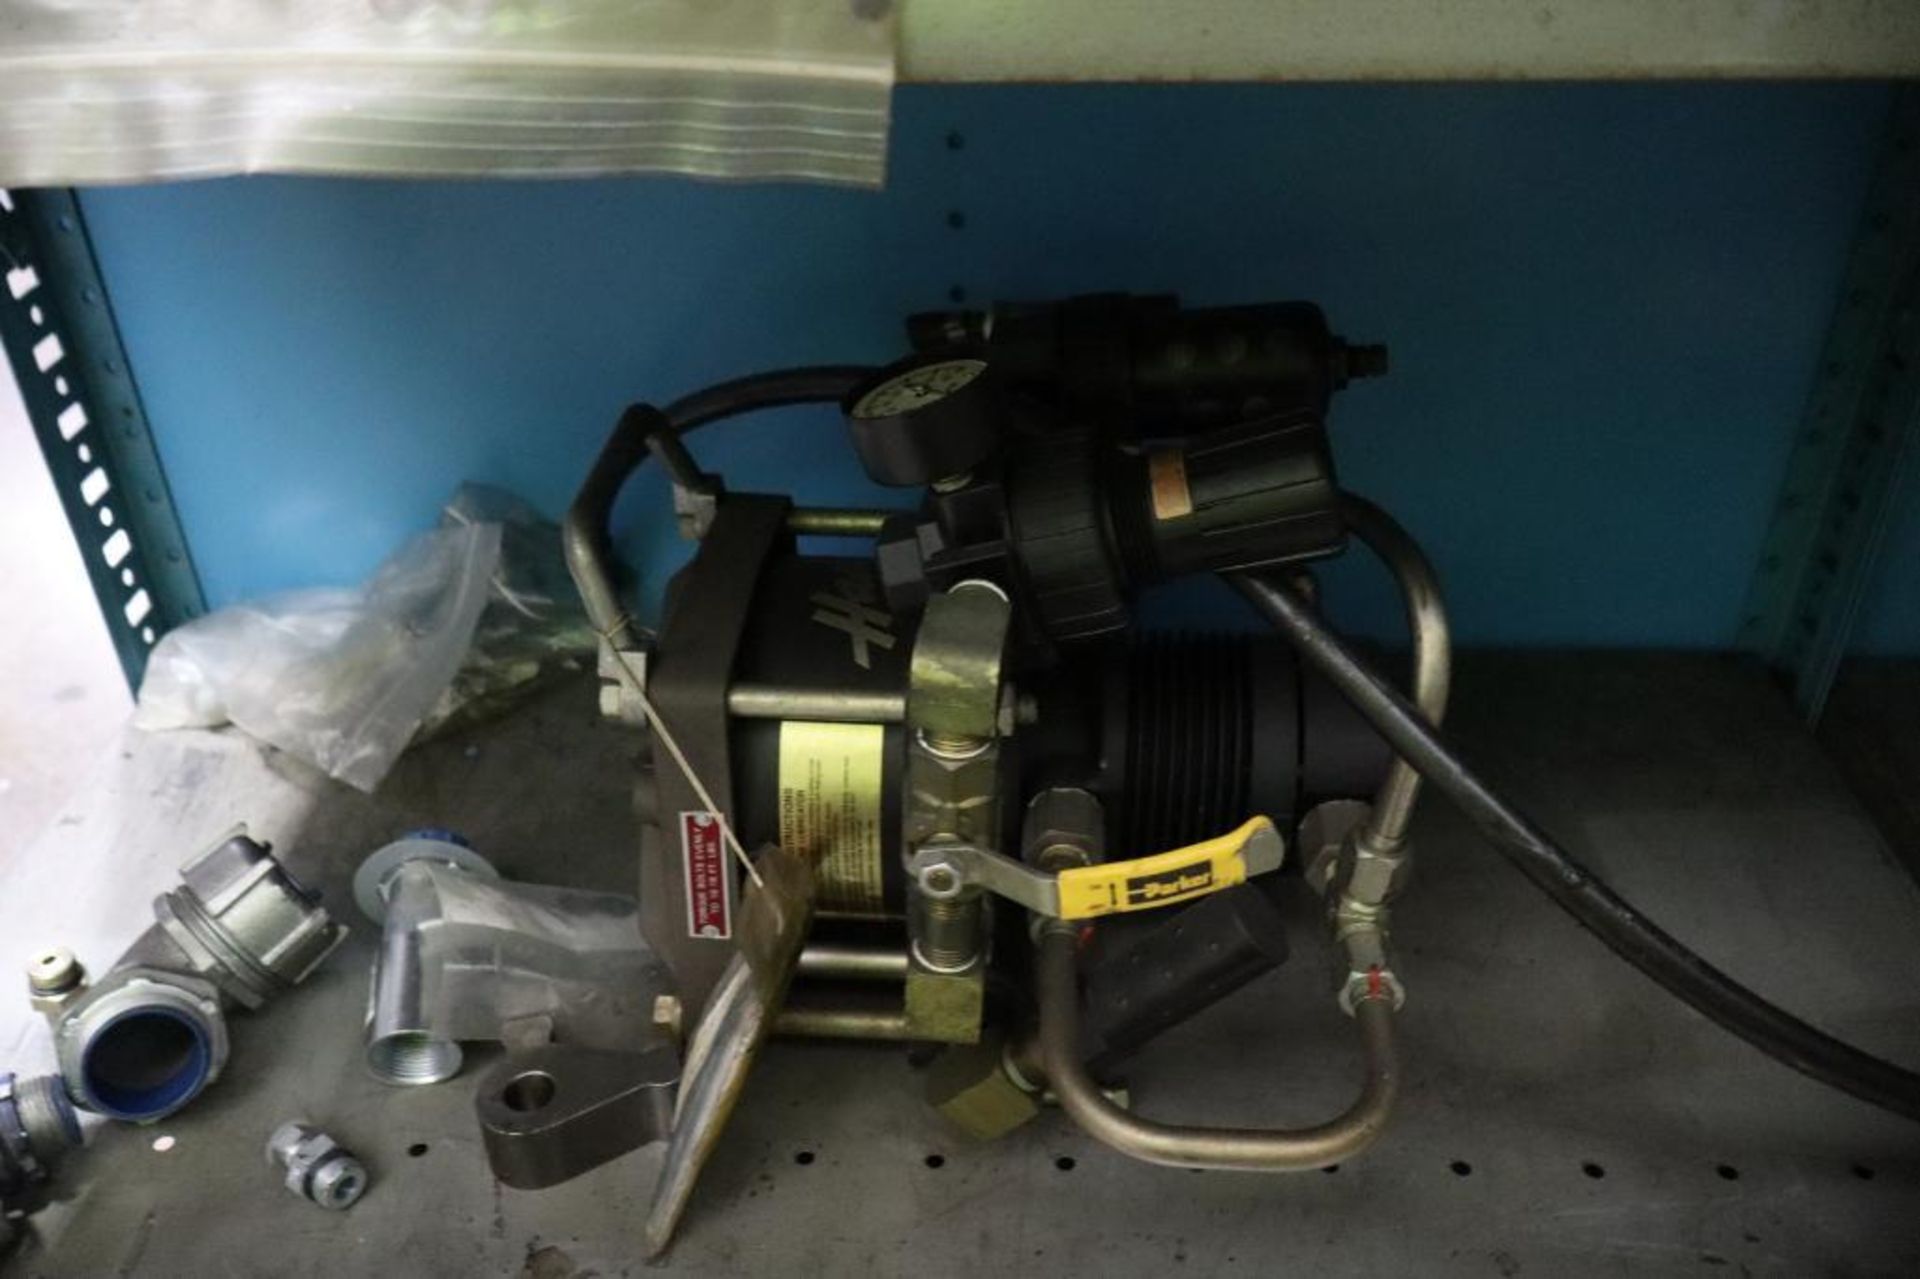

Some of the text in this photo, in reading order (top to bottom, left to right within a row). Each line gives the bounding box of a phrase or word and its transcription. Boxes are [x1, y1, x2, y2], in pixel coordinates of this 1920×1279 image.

[693, 827, 704, 860] EVENLY
[695, 863, 705, 889] BOLTS
[1144, 873, 1211, 898] Parker
